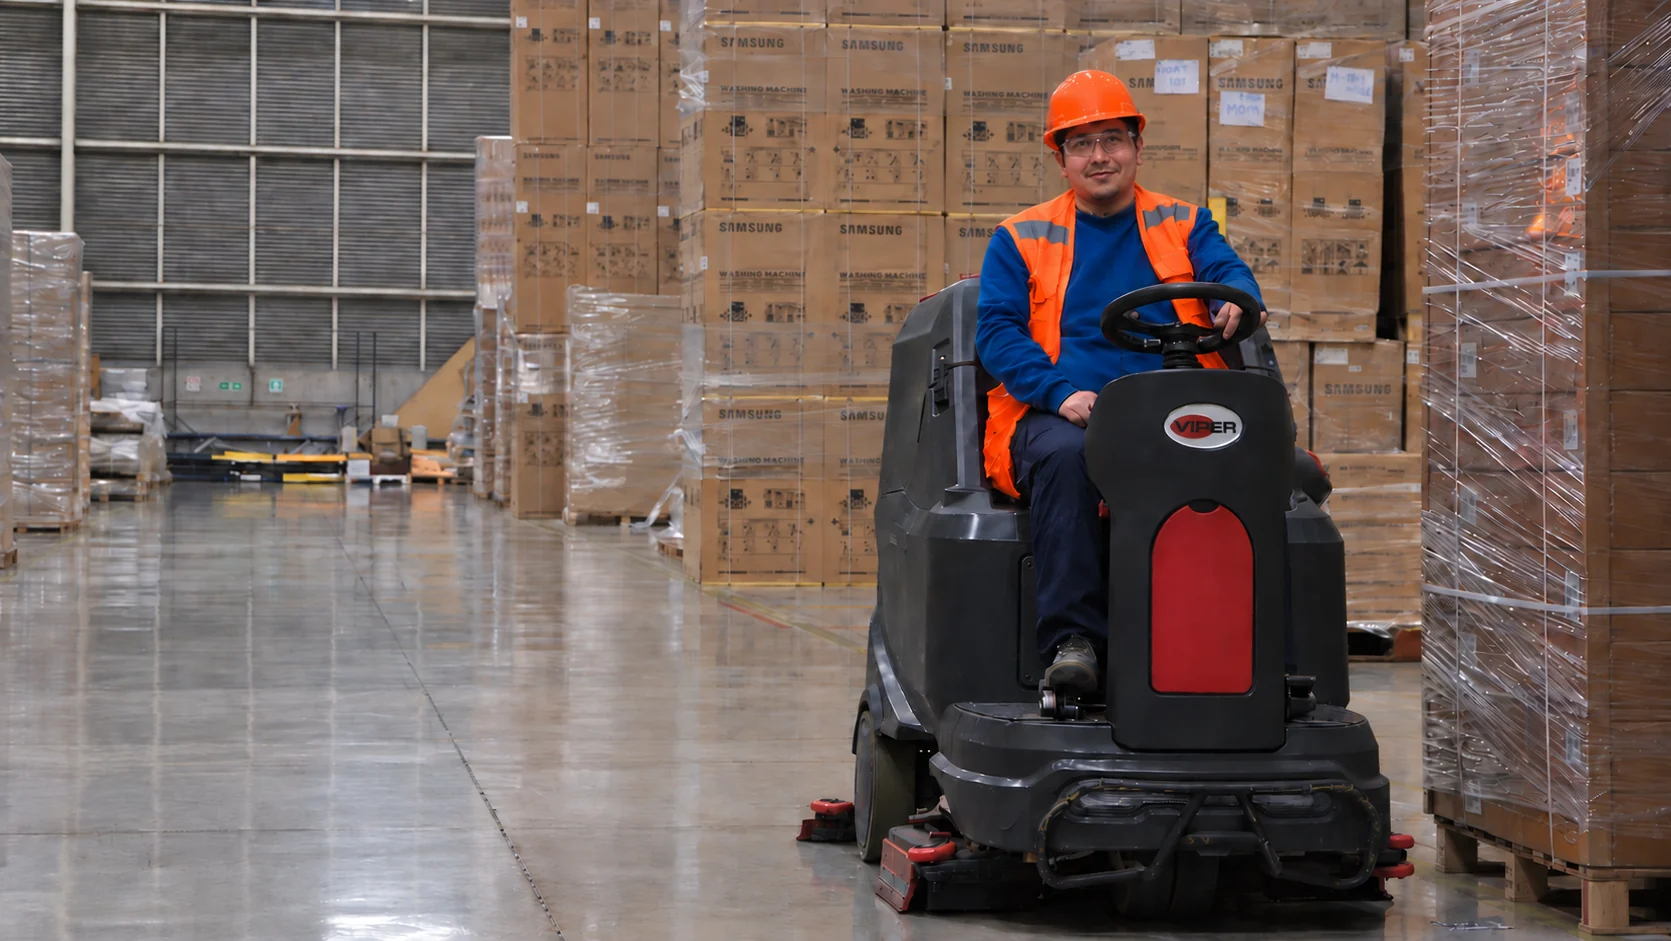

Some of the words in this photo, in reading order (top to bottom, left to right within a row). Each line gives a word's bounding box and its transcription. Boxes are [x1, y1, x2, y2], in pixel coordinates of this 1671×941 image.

[842, 39, 904, 51] SAMSUNG
[963, 42, 1024, 54] SAMSUNG
[721, 85, 763, 93] WASHING
[1218, 78, 1283, 89] SAMSUNG
[720, 222, 783, 233] SAMSUNG
[840, 224, 903, 235] SAMSUNG
[1324, 383, 1392, 395] SAMSUNG
[719, 409, 782, 420] SAMSUNG
[1174, 420, 1237, 434] VIPER
